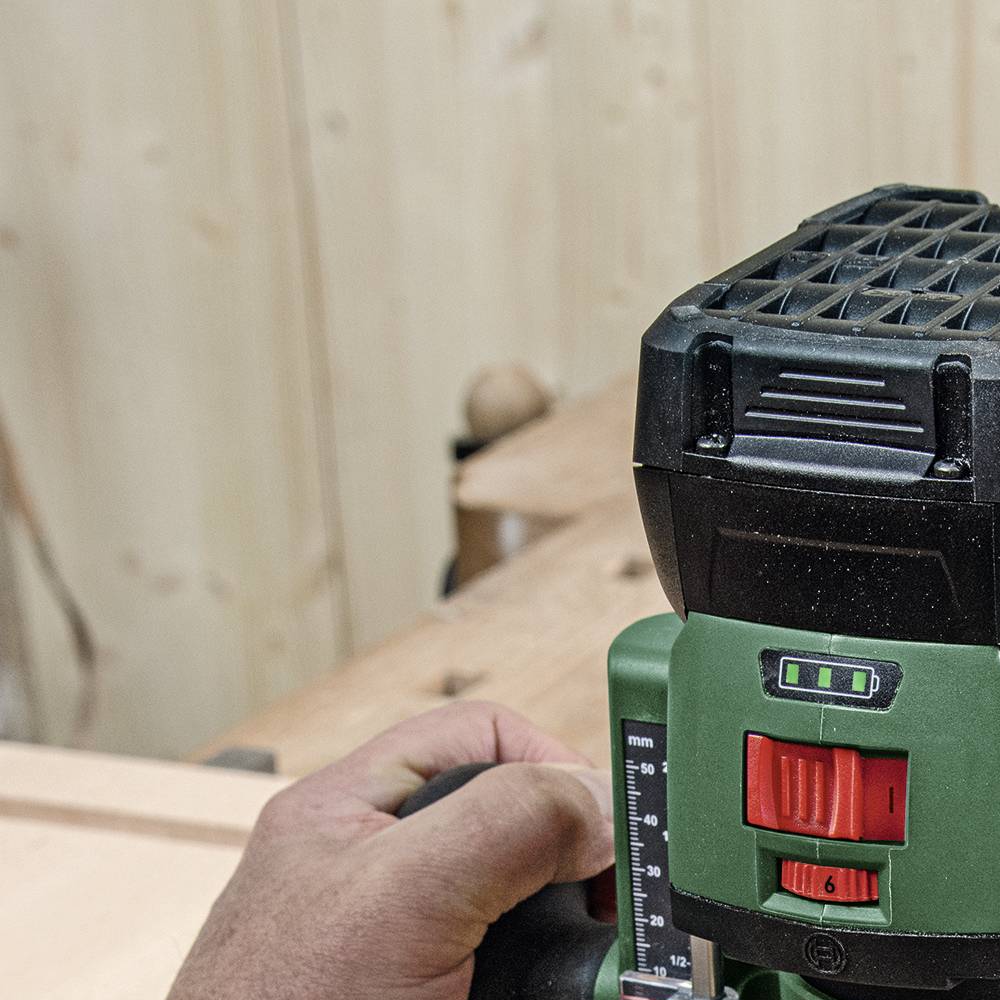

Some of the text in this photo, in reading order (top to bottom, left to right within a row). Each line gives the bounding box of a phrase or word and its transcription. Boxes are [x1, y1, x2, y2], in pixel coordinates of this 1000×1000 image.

[628, 735, 654, 749] mm
[640, 763, 655, 775] 50
[643, 814, 658, 826] 40
[647, 865, 661, 878] 30
[824, 875, 836, 894] 6
[650, 915, 664, 927] 20
[653, 966, 667, 977] 10
